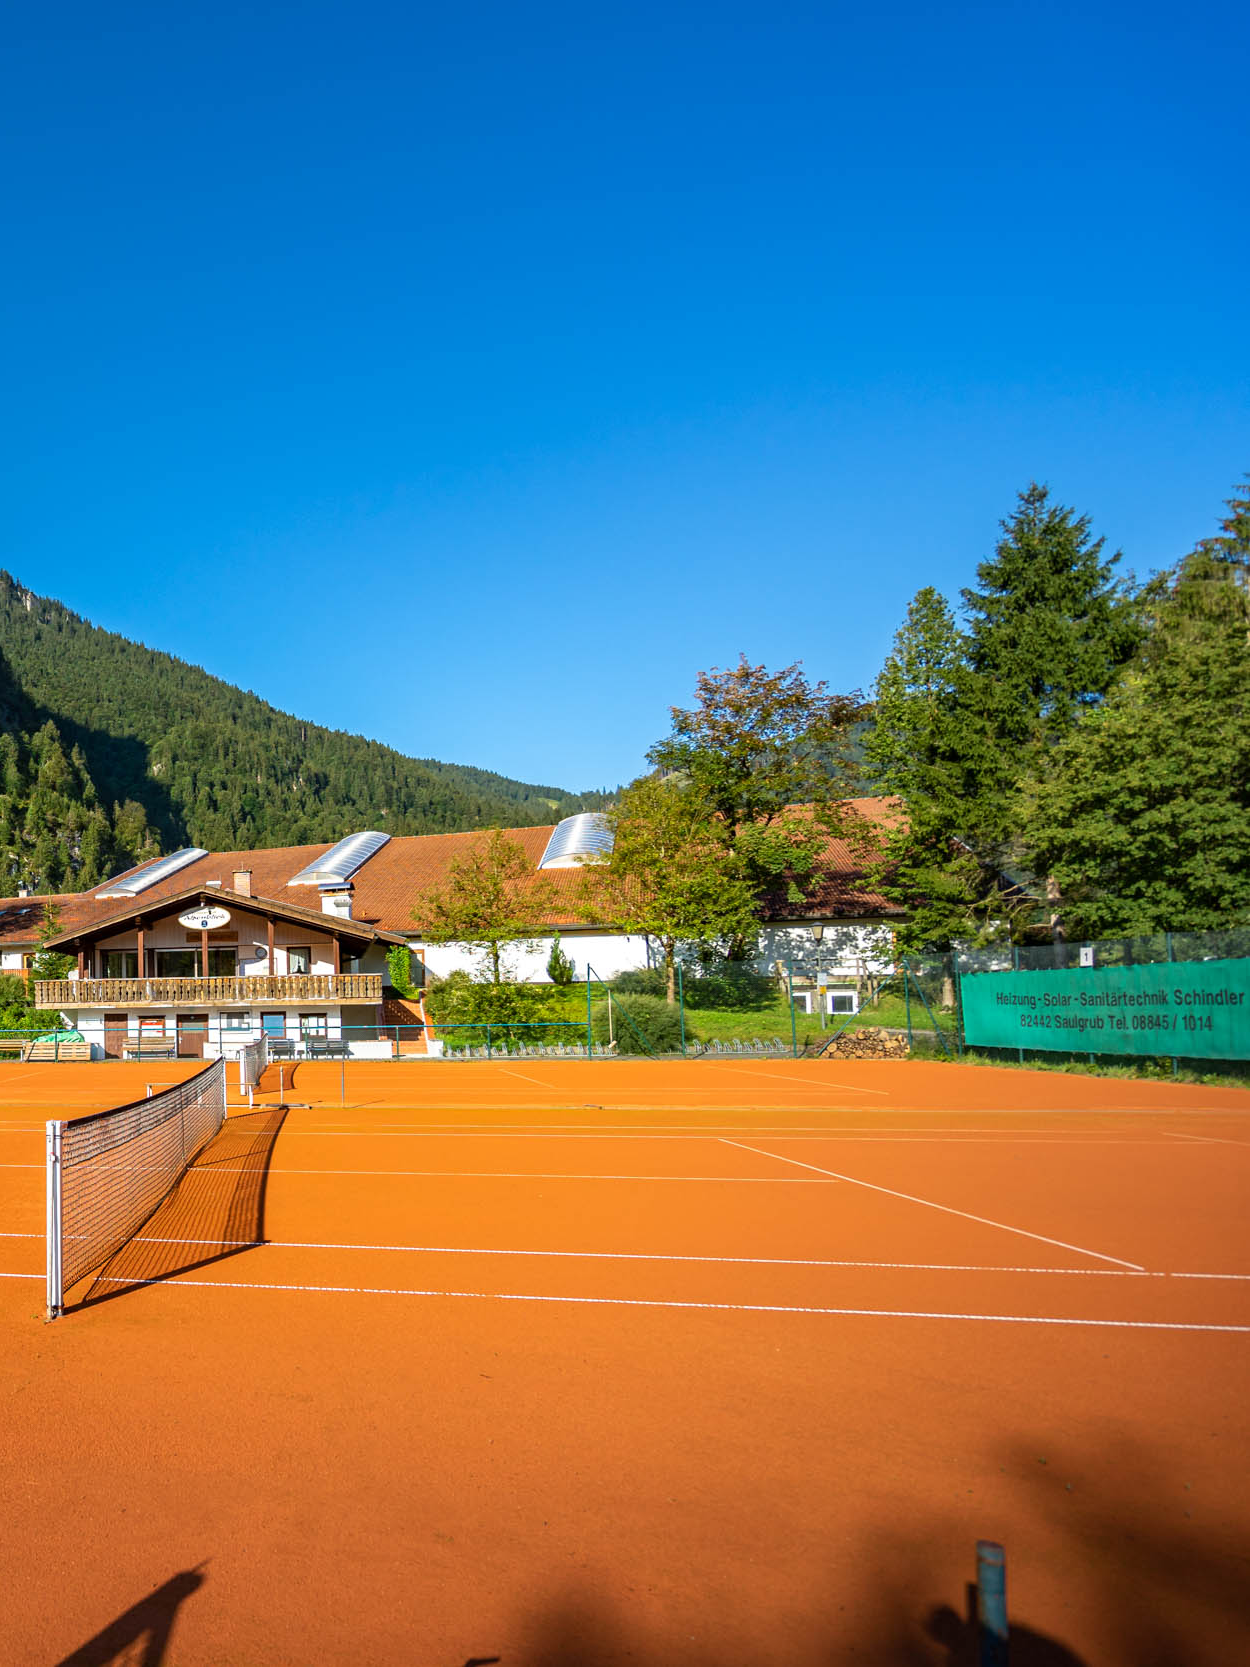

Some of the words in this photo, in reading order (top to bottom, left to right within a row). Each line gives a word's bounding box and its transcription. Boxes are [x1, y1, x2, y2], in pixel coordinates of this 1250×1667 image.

[1174, 988, 1245, 1006] Schindler
[1020, 1014, 1052, 1028] 82442
[1054, 1014, 1104, 1032] Saulgrub
[1108, 1015, 1129, 1030] Tel.
[1182, 1014, 1212, 1031] 1014
